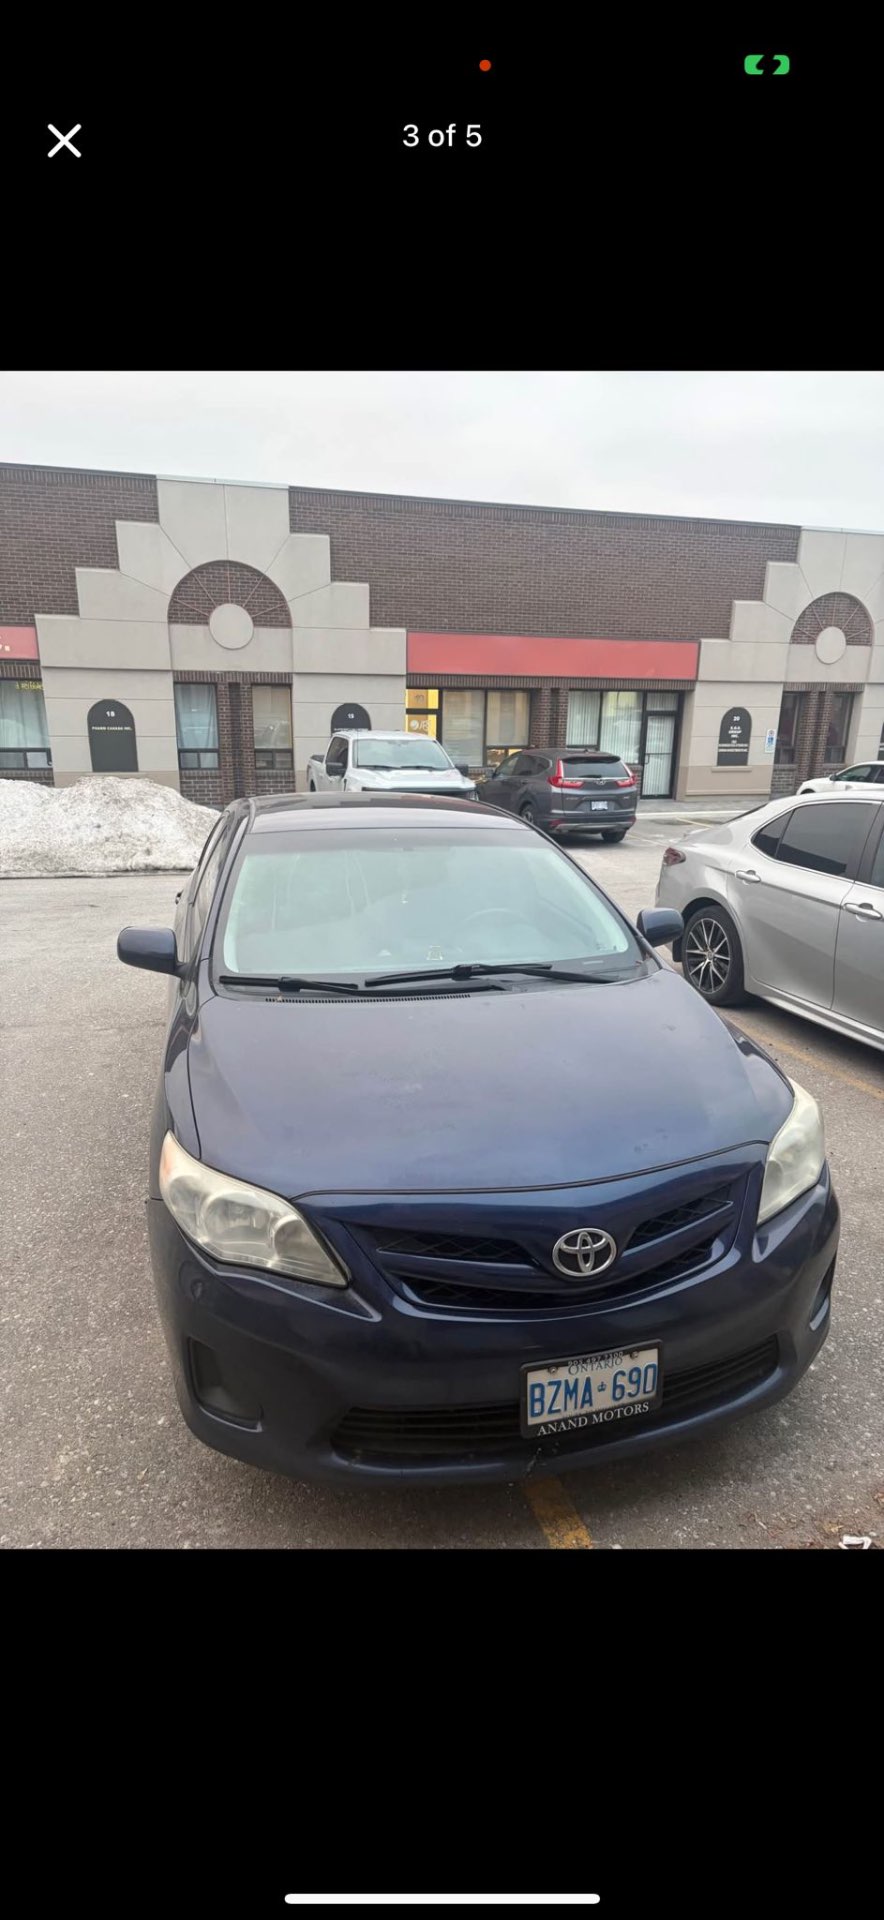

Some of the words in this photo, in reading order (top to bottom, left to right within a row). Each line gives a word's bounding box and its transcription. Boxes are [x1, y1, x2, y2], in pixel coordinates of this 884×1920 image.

[529, 1376, 593, 1418] BZMA
[612, 1363, 658, 1401] 690
[537, 1416, 588, 1436] ANAND
[592, 1402, 649, 1424] MOTORS
